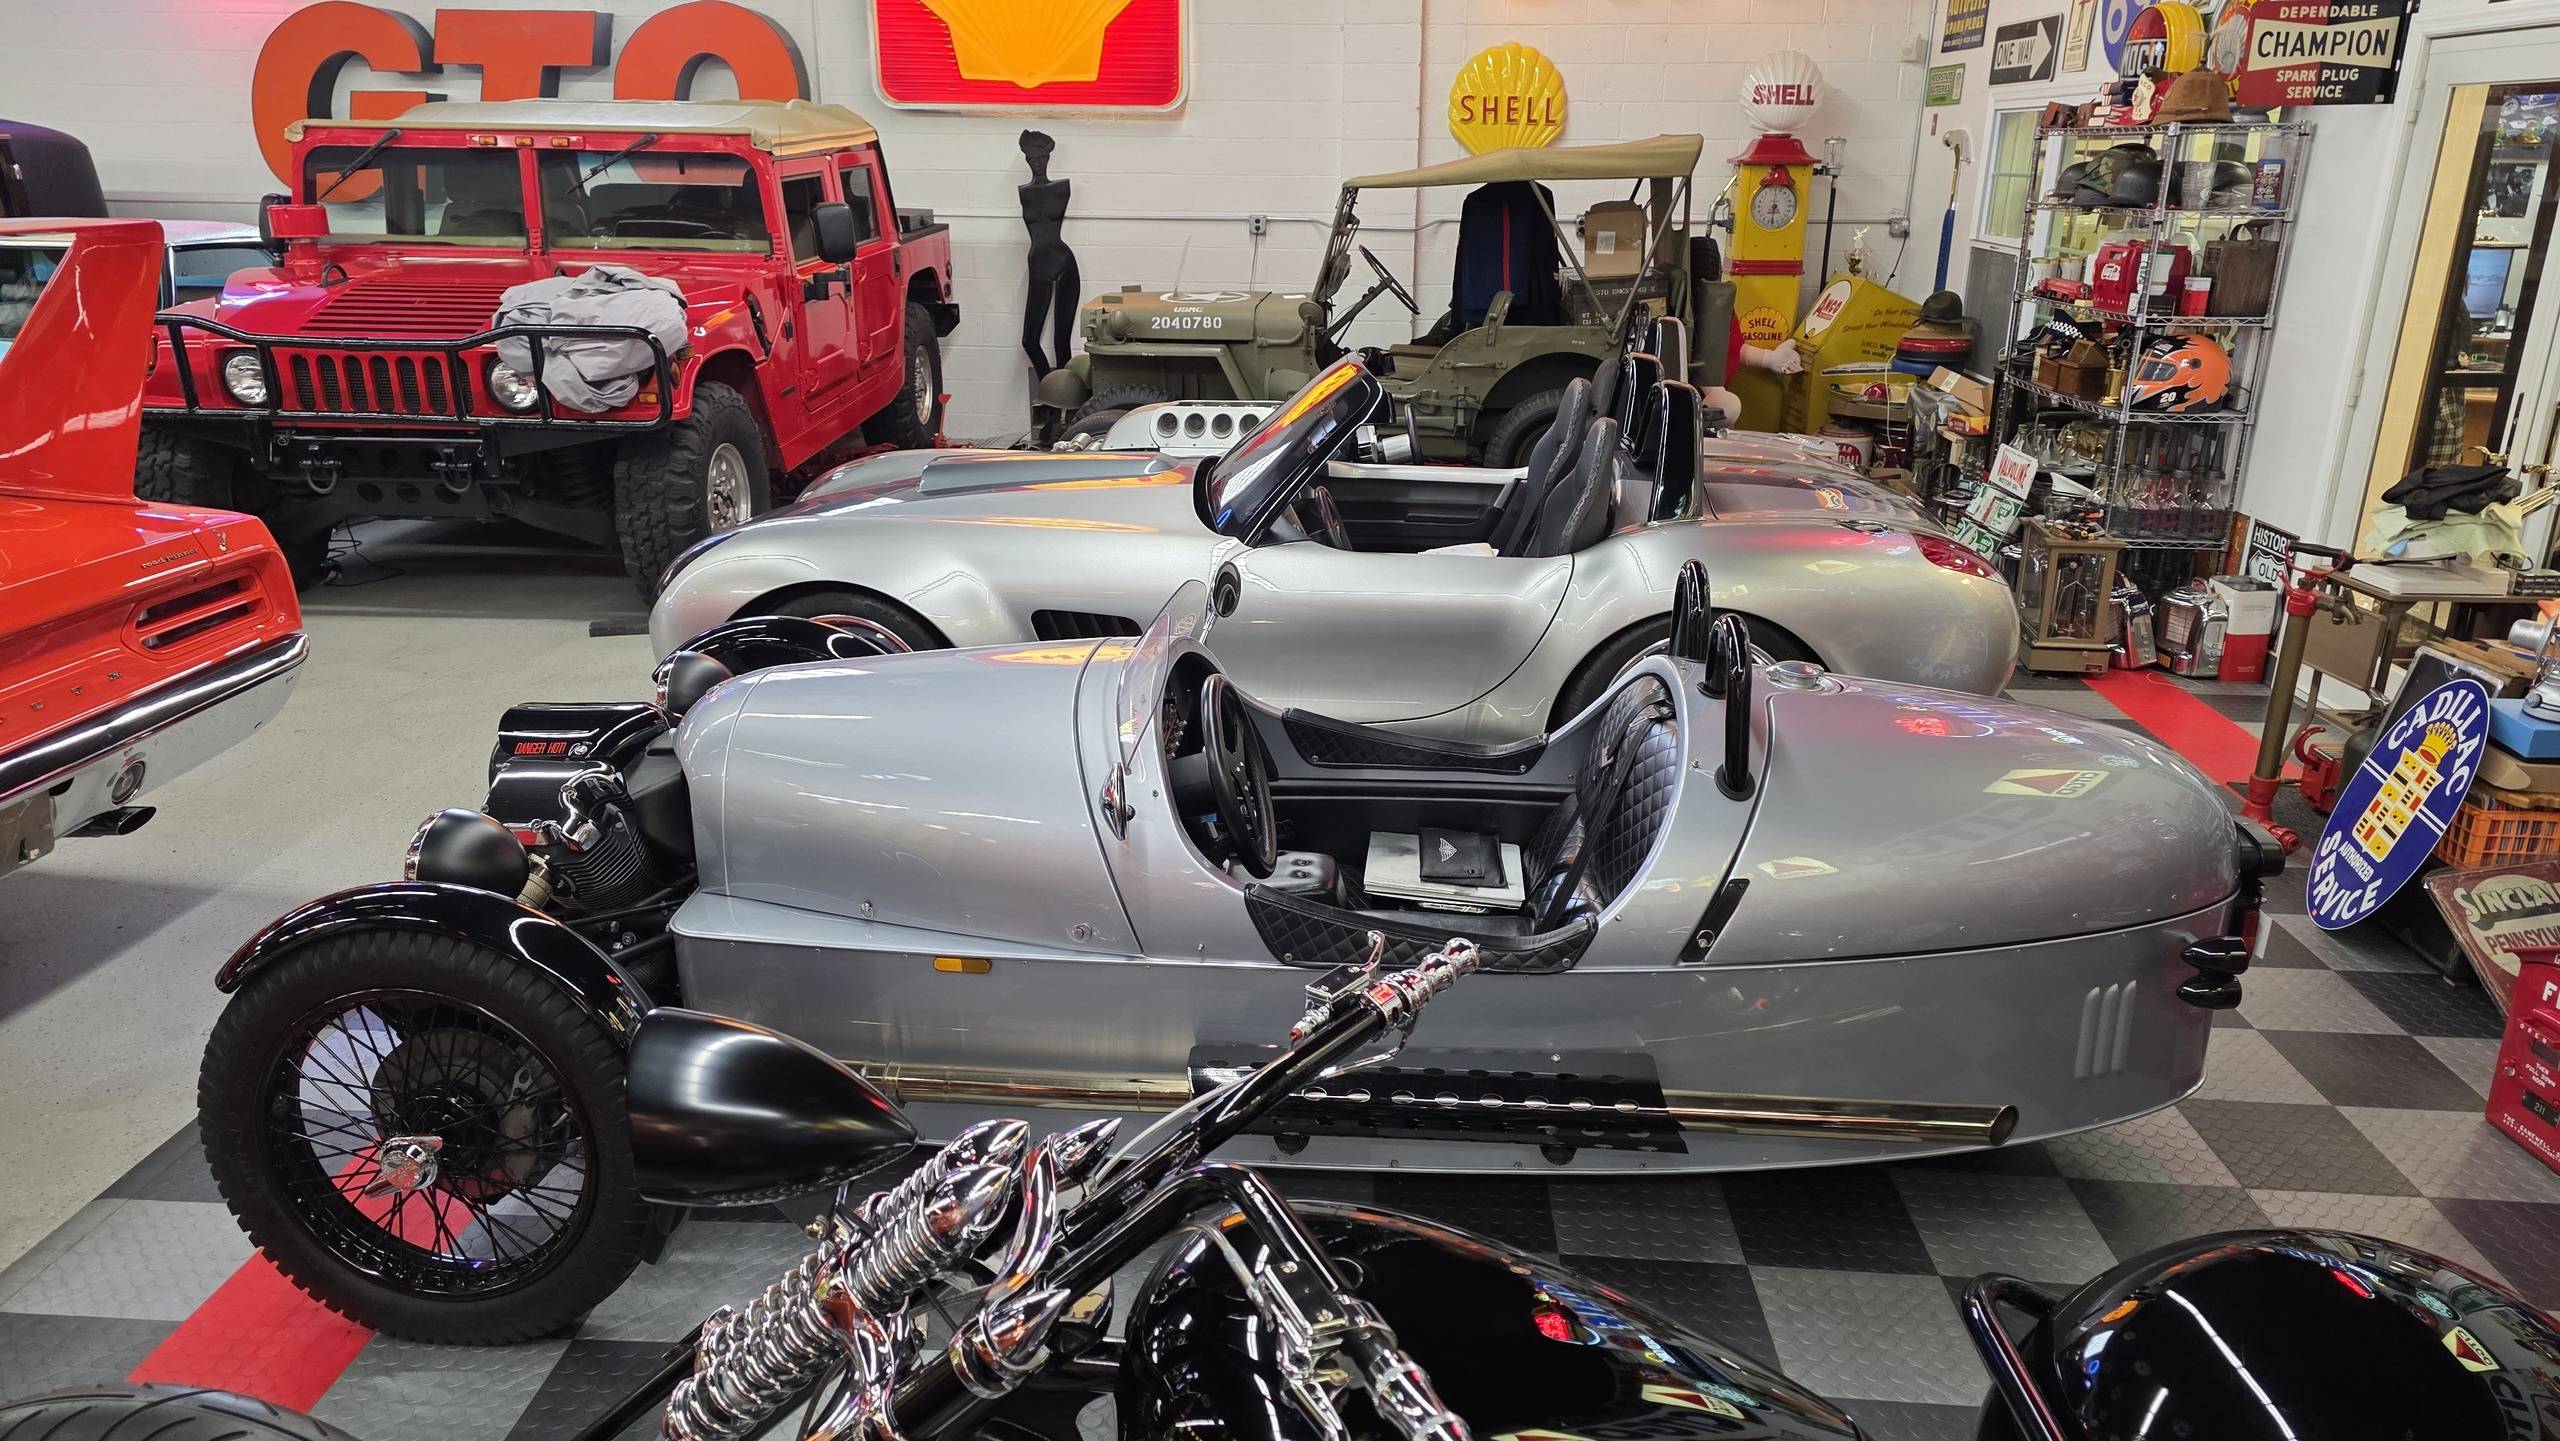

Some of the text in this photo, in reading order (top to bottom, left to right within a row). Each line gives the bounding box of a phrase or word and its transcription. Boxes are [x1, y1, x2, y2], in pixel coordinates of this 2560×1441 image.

[2280, 5, 2378, 19] DEPENDABLE
[1996, 39, 2036, 67] ONE WAY
[2257, 29, 2390, 58] CHAMPION
[2276, 68, 2359, 83] SPARK PLUG
[1752, 84, 1815, 106] SHELL
[2286, 85, 2344, 99] SERVICE
[1460, 95, 1557, 125] SHELL
[1812, 293, 1843, 316] ANCO
[1151, 316, 1222, 330] 2040780
[1748, 318, 1777, 329] SHELL
[1743, 332, 1783, 341] GASOLINE
[2160, 391, 2177, 403] 20
[2258, 562, 2277, 582] OLD
[514, 742, 567, 754] DANGER HOT!
[2388, 689, 2482, 797] CADILLAC
[2338, 841, 2375, 882] AUTHORIZED
[2314, 830, 2384, 921] SERVICE
[2453, 883, 2560, 923] SINCLAI
[2534, 1102, 2546, 1115] 211
